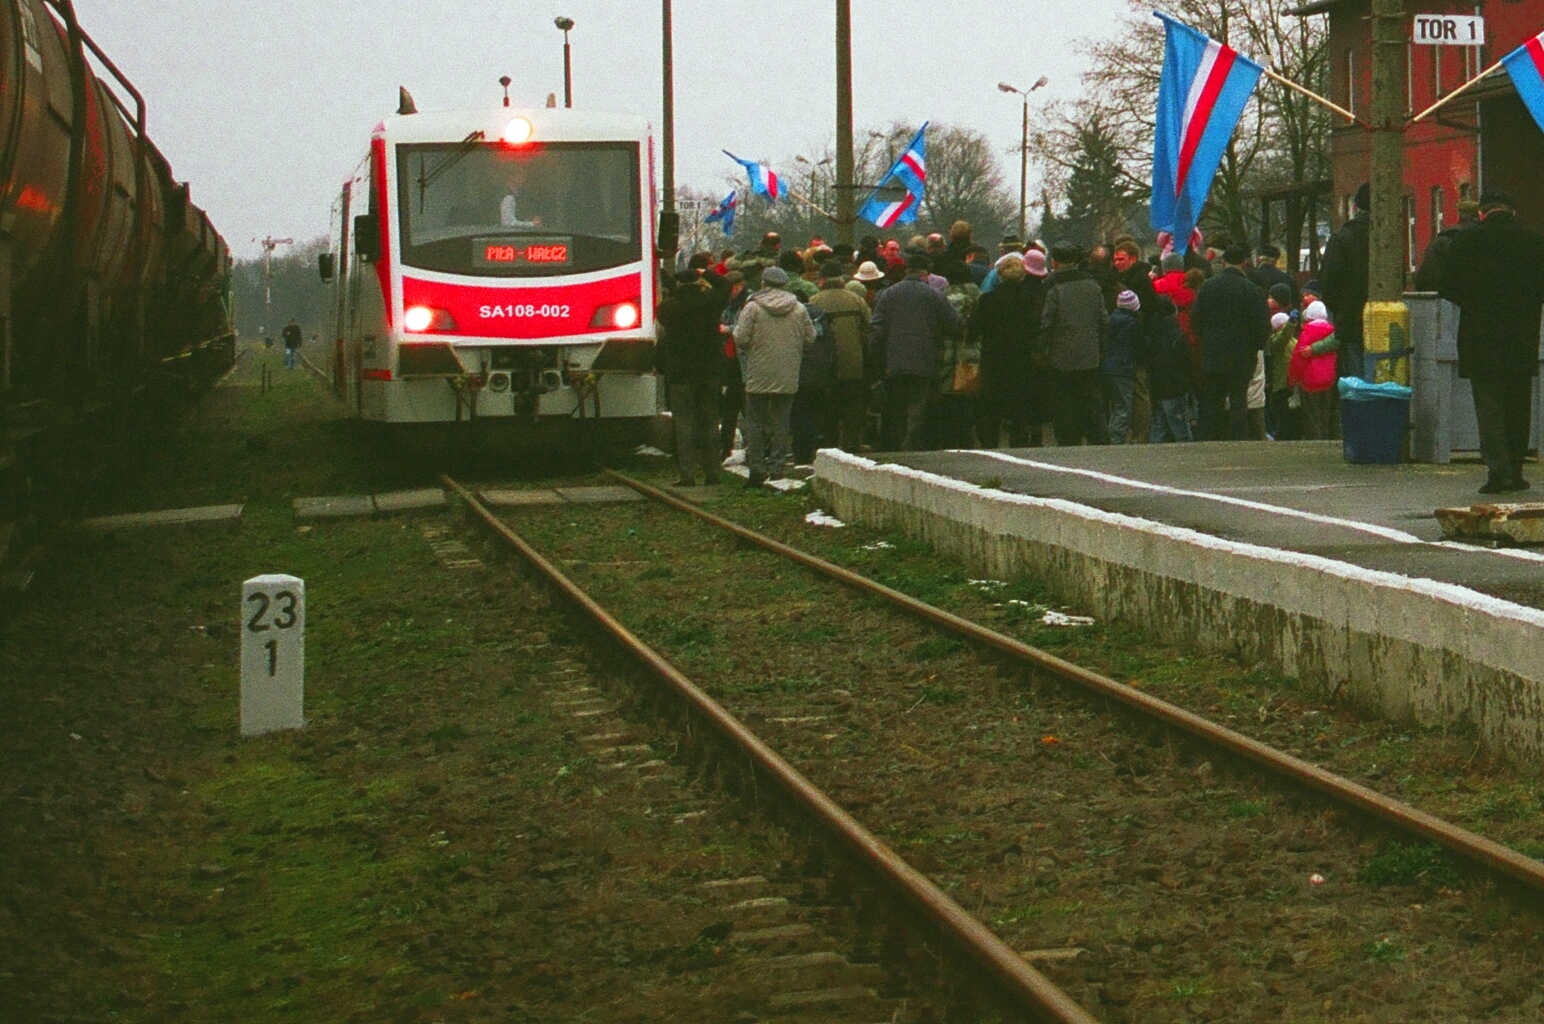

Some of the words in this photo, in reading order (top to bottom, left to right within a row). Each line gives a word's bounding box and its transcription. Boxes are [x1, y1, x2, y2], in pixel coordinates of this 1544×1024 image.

[1417, 18, 1457, 40] TOR
[1467, 20, 1476, 40] 1
[479, 304, 570, 318] SA108-002
[247, 590, 297, 633] 23
[264, 639, 278, 677] 1
